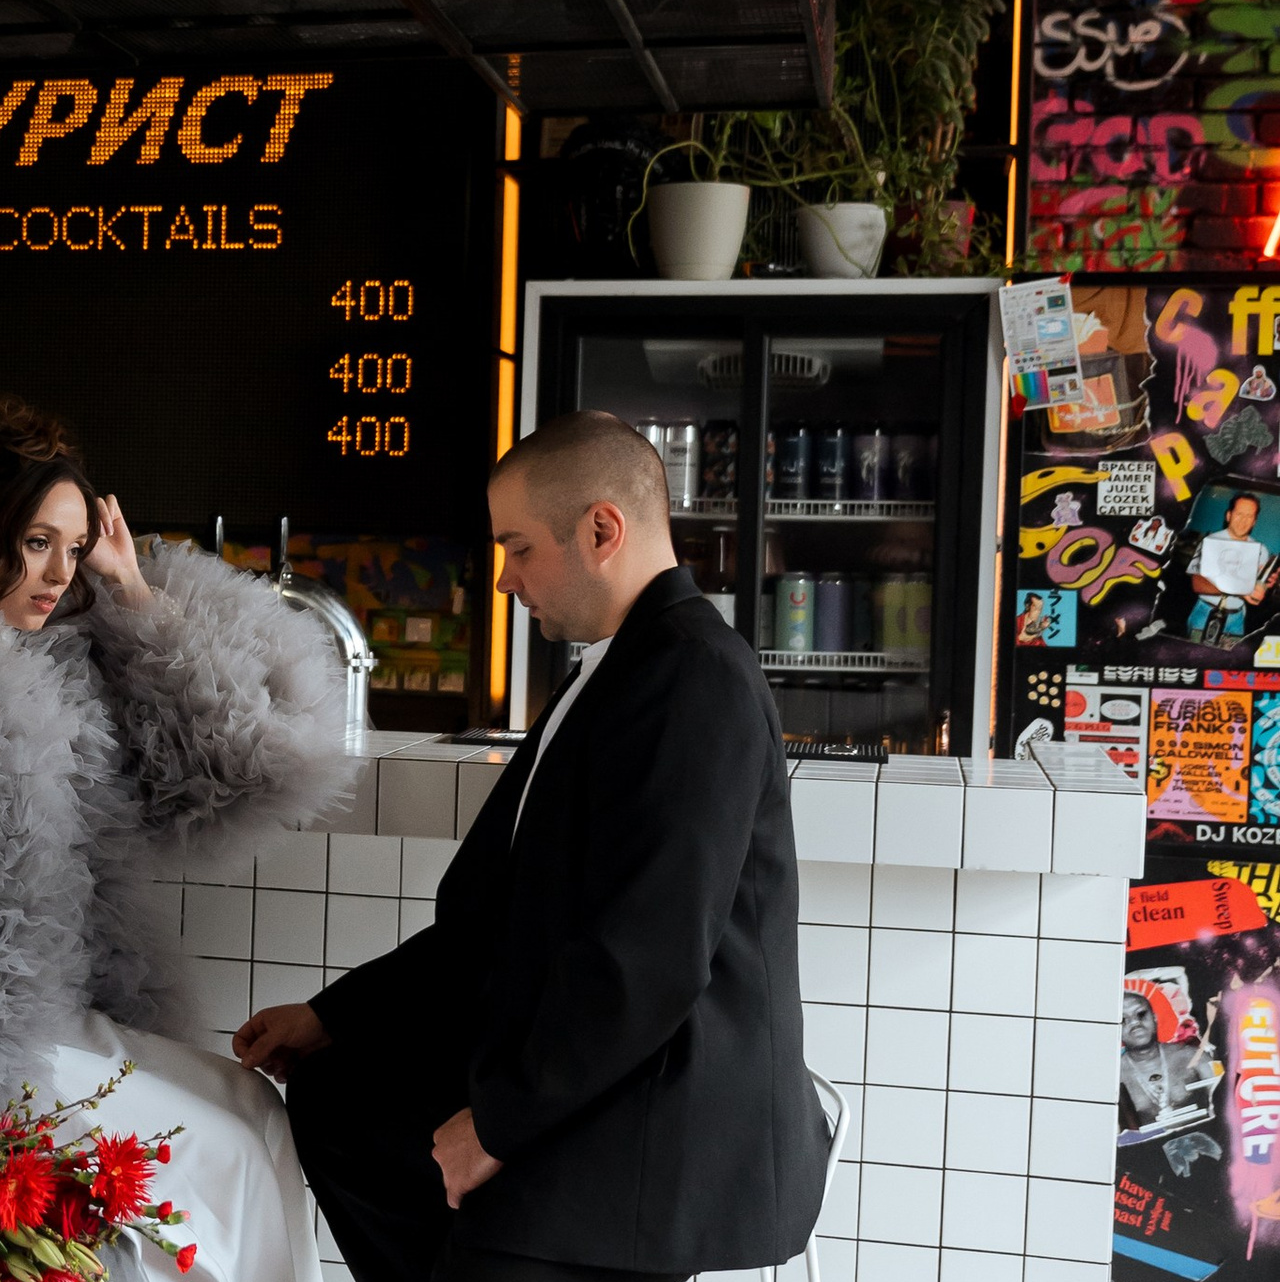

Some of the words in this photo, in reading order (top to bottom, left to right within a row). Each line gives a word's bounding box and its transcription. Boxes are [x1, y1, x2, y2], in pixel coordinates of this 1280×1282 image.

[330, 278, 415, 322] 400
[328, 352, 413, 395] 400
[326, 414, 411, 458] 400
[1100, 462, 1155, 473] SPACER
[1106, 484, 1148, 494] JUICE
[1152, 703, 1249, 724] FURIOUS
[1152, 721, 1225, 735] FRANK
[1152, 749, 1245, 761] CALDWELL
[1192, 741, 1245, 752] SIMON
[1195, 823, 1227, 843] DJ
[1140, 890, 1170, 904] field
[1131, 905, 1186, 923] clean
[1119, 1174, 1154, 1202] have
